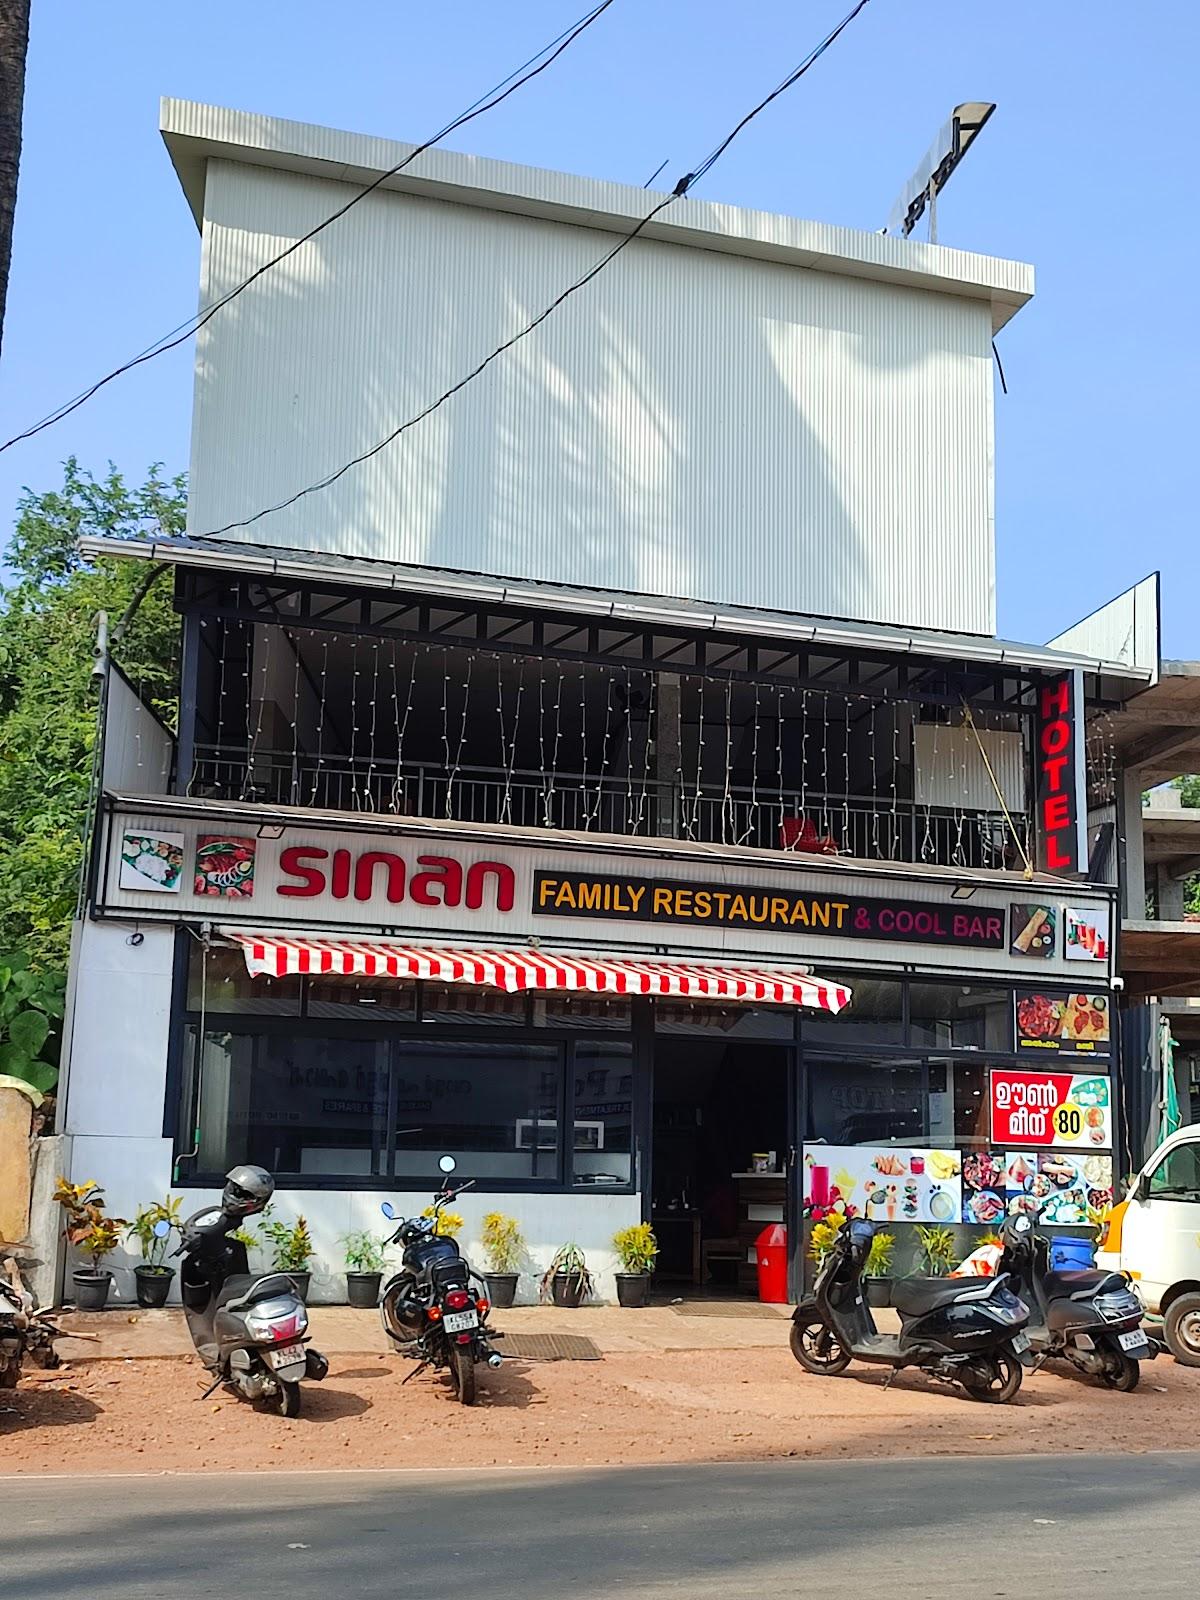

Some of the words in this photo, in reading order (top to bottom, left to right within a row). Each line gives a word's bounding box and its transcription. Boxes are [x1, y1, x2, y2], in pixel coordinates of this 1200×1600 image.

[1041, 681, 1071, 869] HOTEL
[539, 879, 646, 913] FAMILY
[653, 888, 850, 929] RESTAURANT
[854, 906, 871, 930] &
[878, 908, 948, 937] COOL
[952, 914, 1001, 940] BAR
